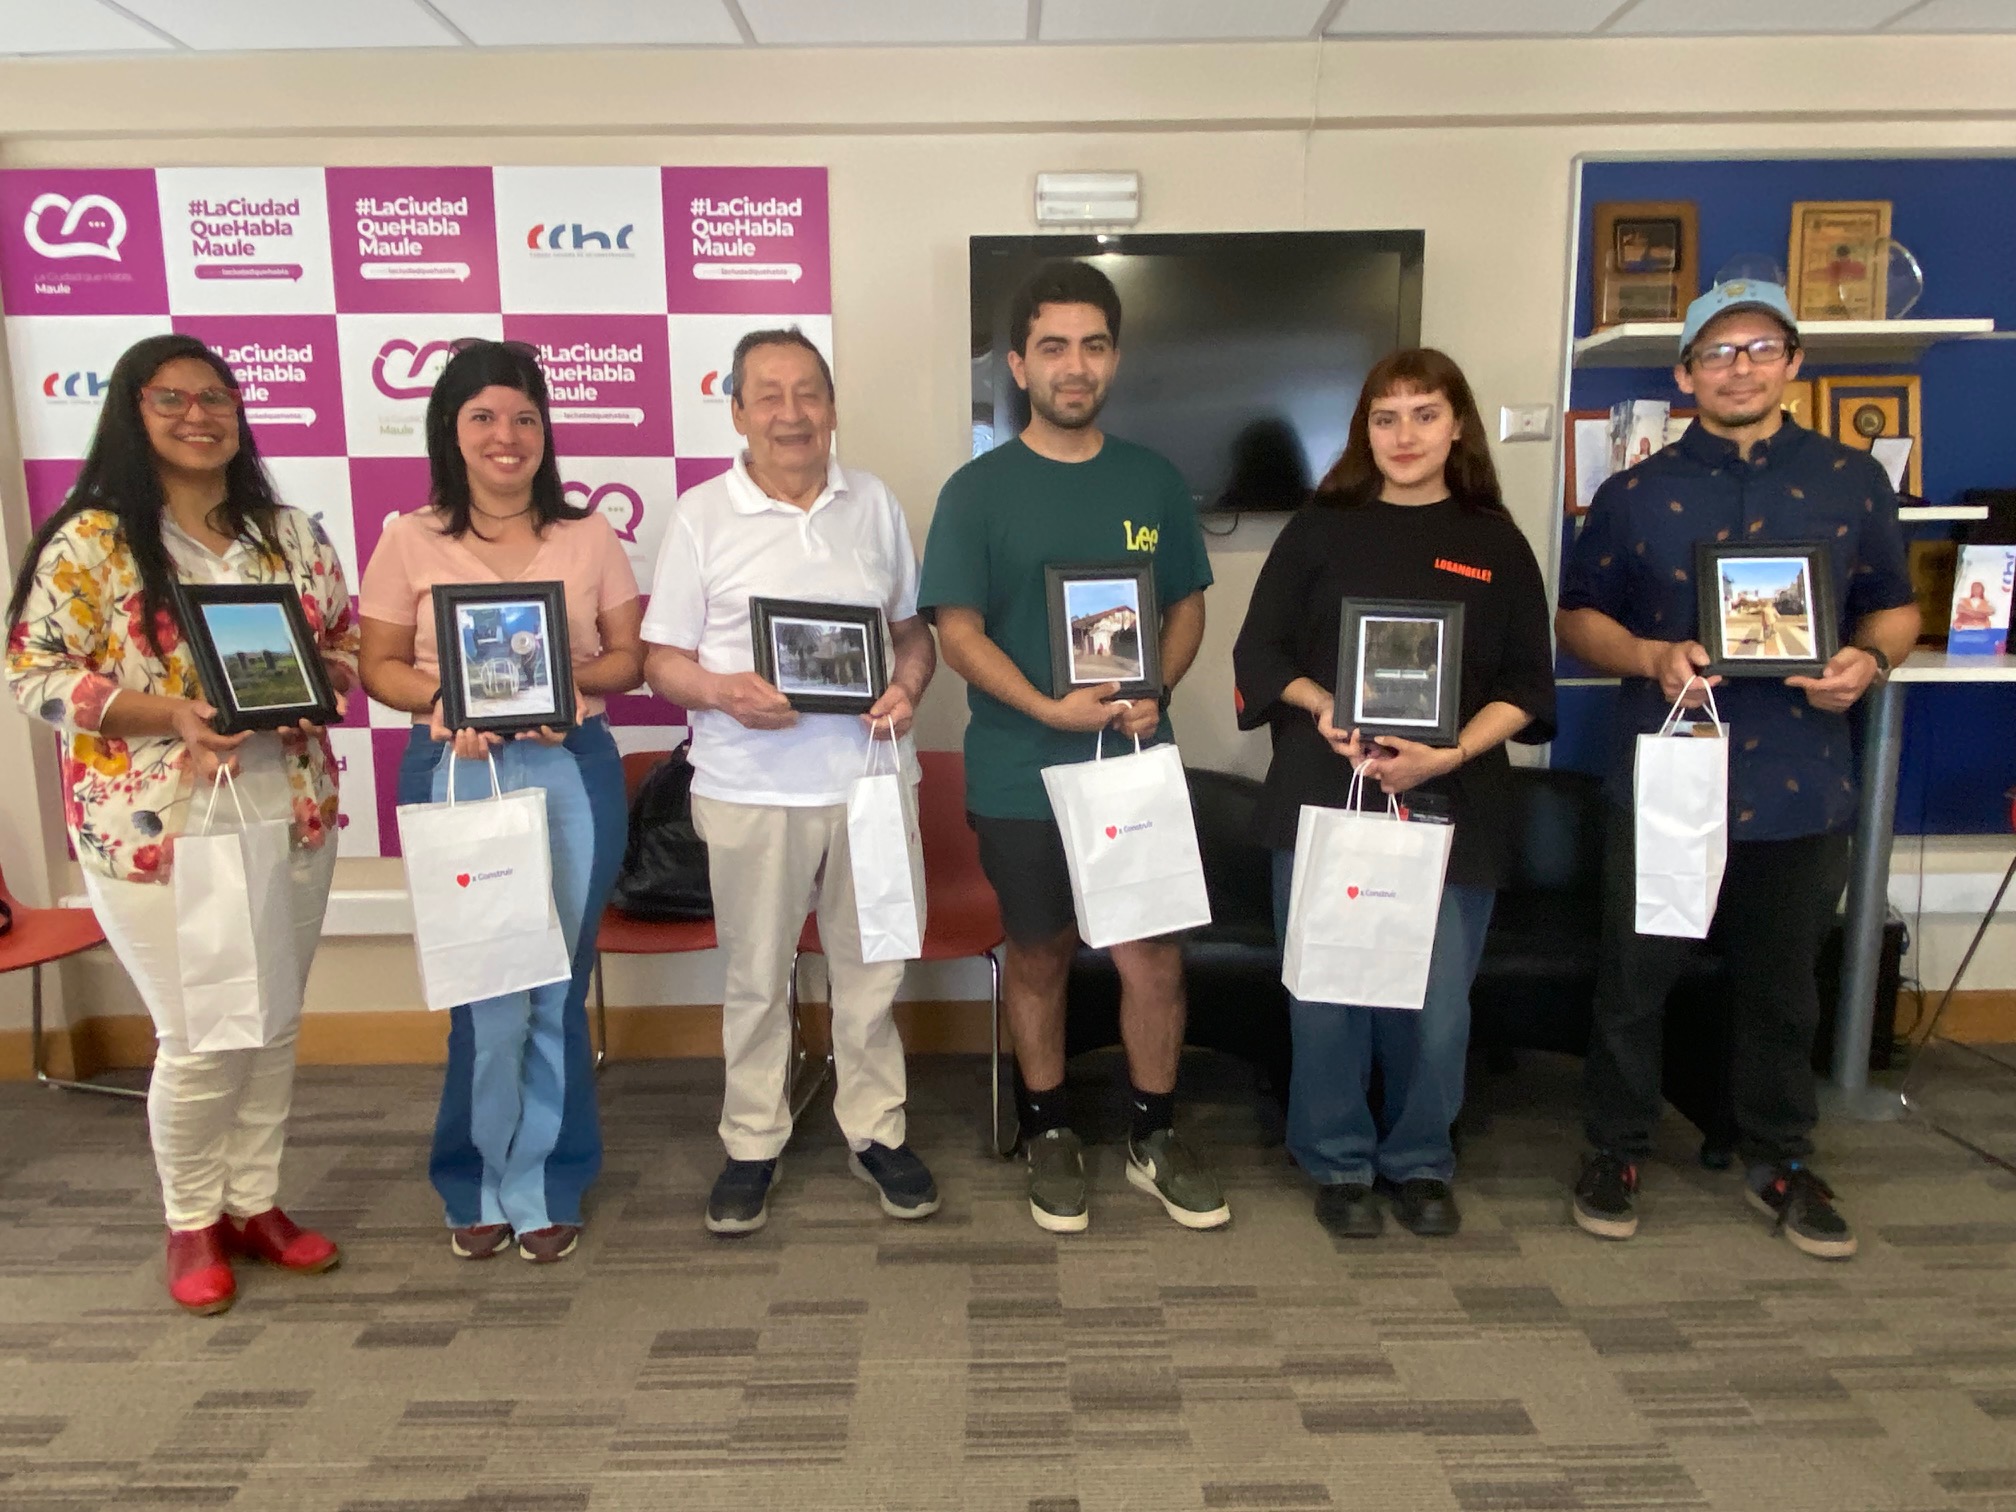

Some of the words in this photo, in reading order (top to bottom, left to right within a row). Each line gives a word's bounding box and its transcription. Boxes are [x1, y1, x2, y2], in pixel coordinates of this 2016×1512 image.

[188, 197, 300, 216] #LaCiudad
[355, 196, 468, 216] #LaCiudad
[690, 196, 802, 216] #LaCiudad
[190, 219, 293, 239] QueHabla
[357, 217, 460, 238] QueHabla
[691, 218, 794, 239] QueHabla
[192, 238, 255, 256] Maule
[359, 237, 422, 256] Maule
[692, 238, 756, 256] Maule
[34, 283, 71, 294] Maule
[1123, 519, 1158, 553] Lee
